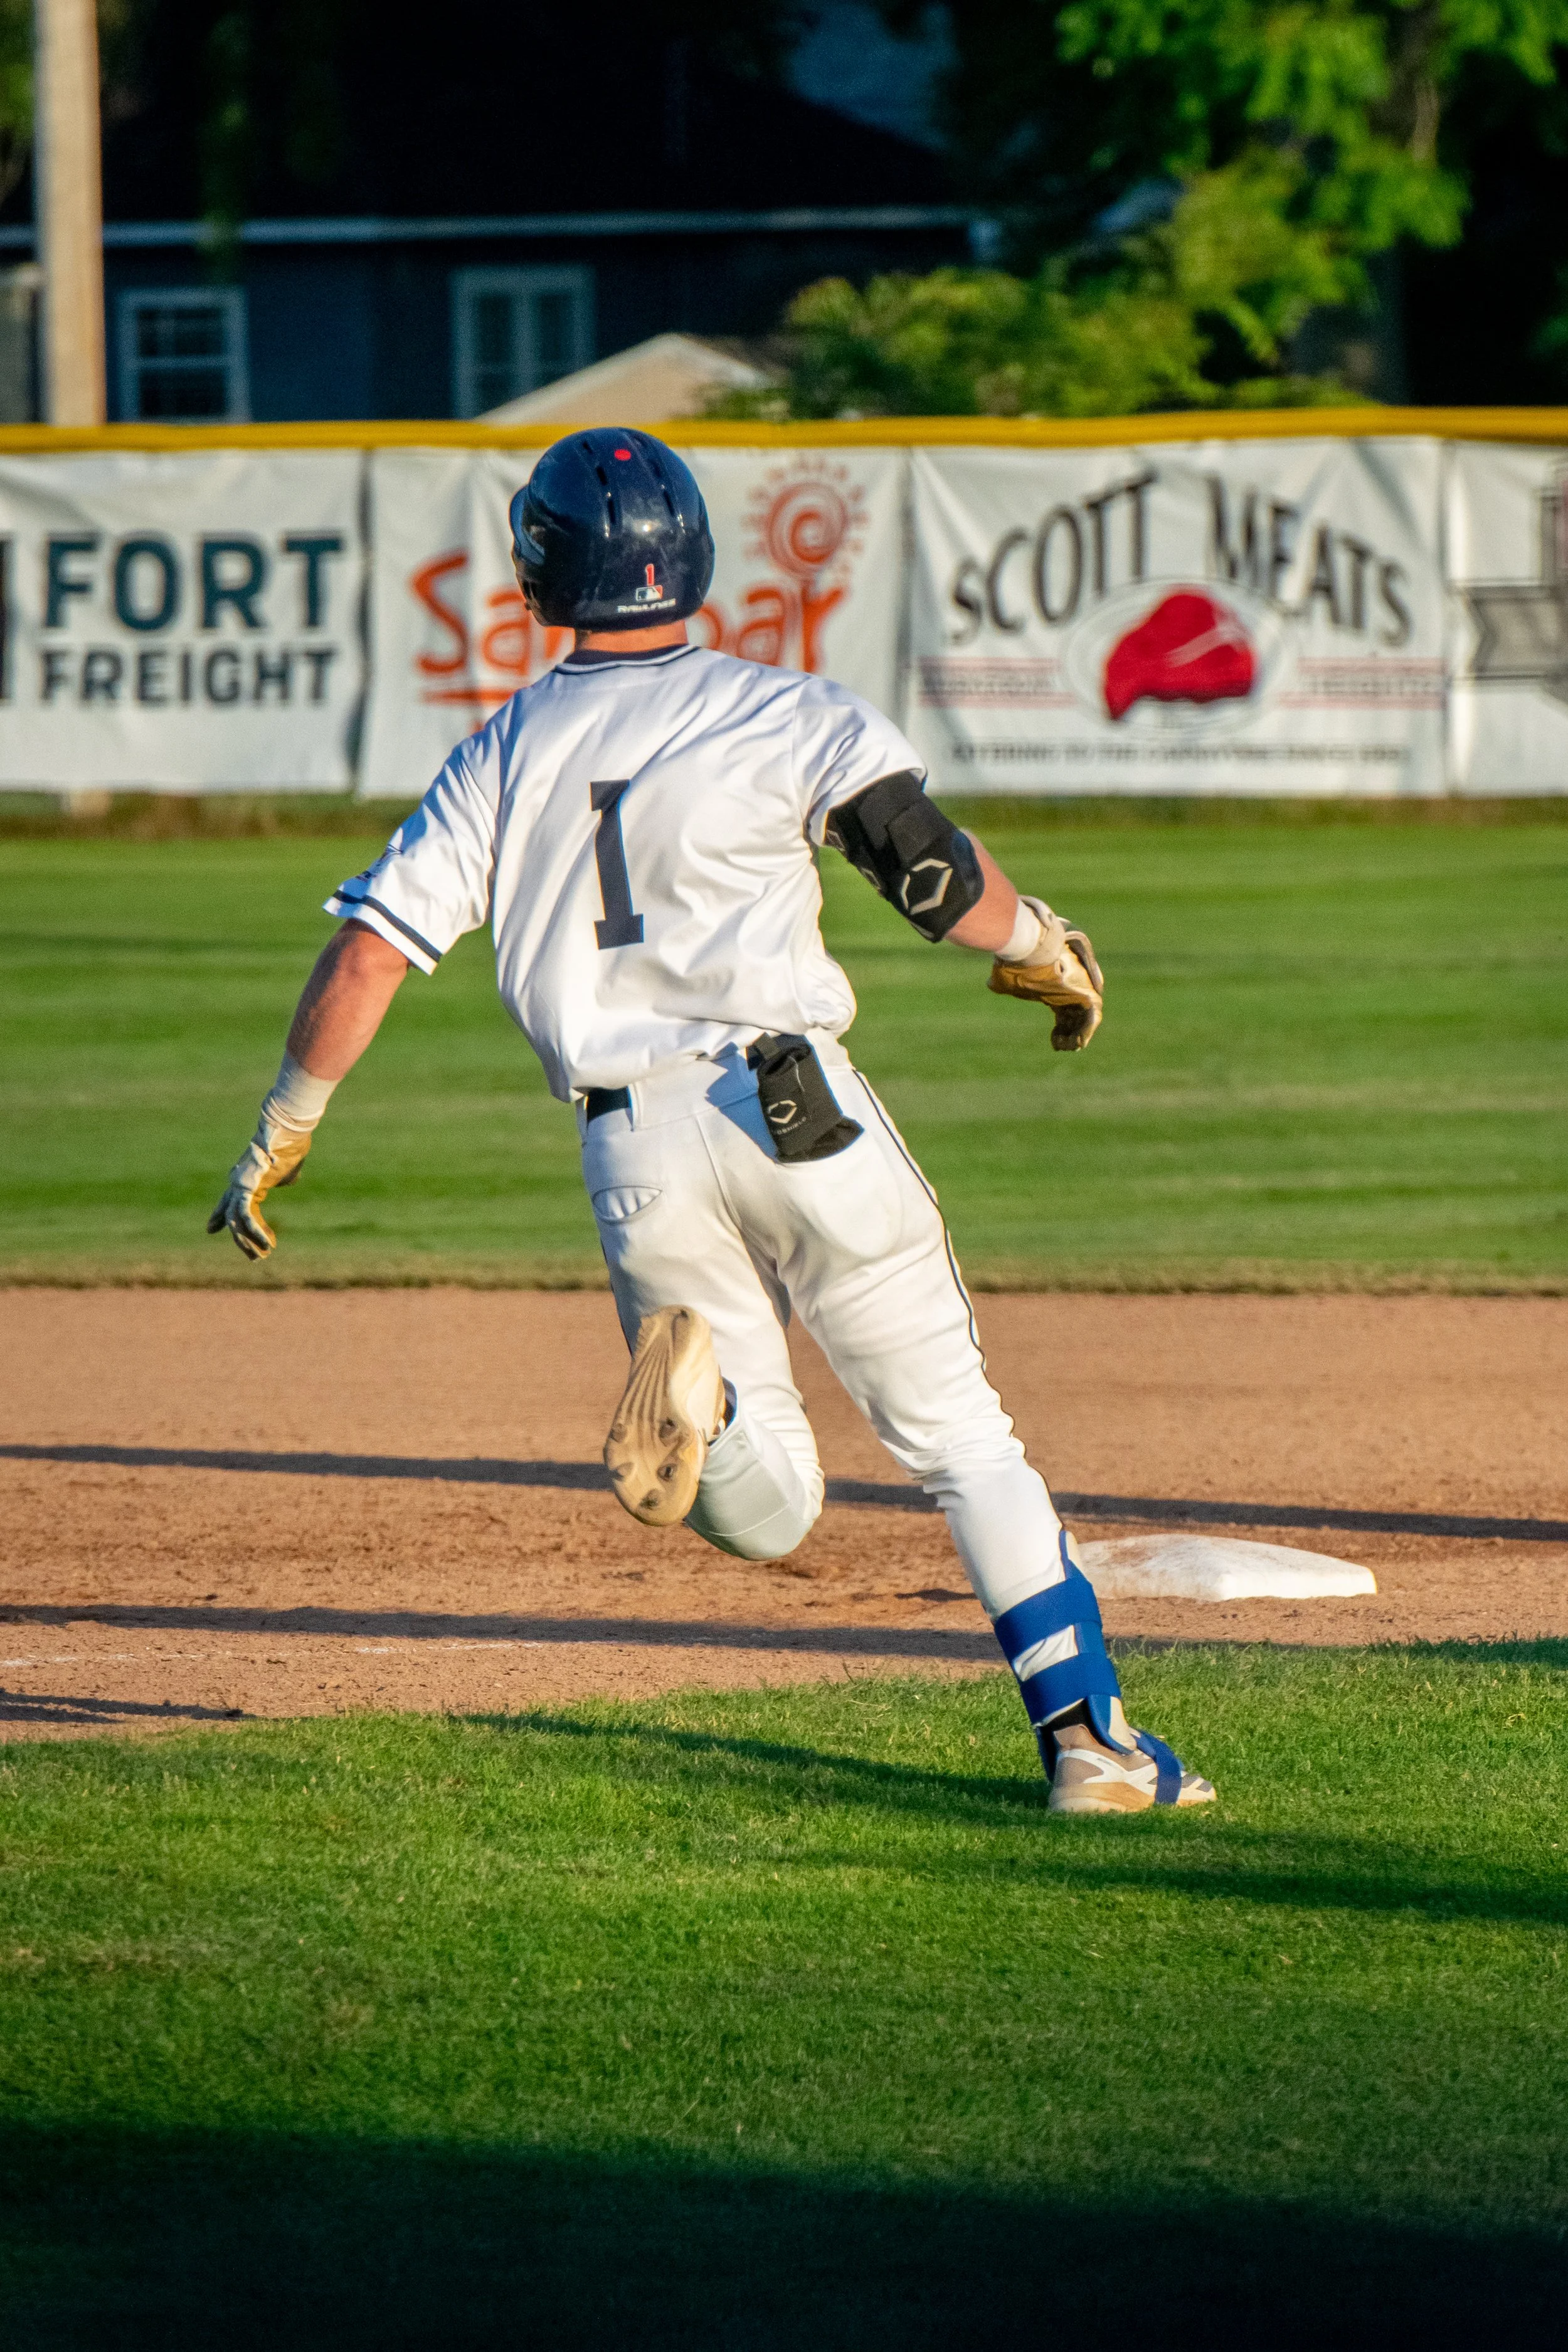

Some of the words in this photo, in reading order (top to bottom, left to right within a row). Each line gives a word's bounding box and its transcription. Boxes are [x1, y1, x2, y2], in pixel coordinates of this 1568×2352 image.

[45, 531, 346, 632] FORT
[645, 563, 655, 586] 1
[950, 464, 1160, 645] SCOTT
[1203, 470, 1414, 649] MEATS
[40, 647, 336, 705] FREIGHT
[590, 779, 644, 950] 1
